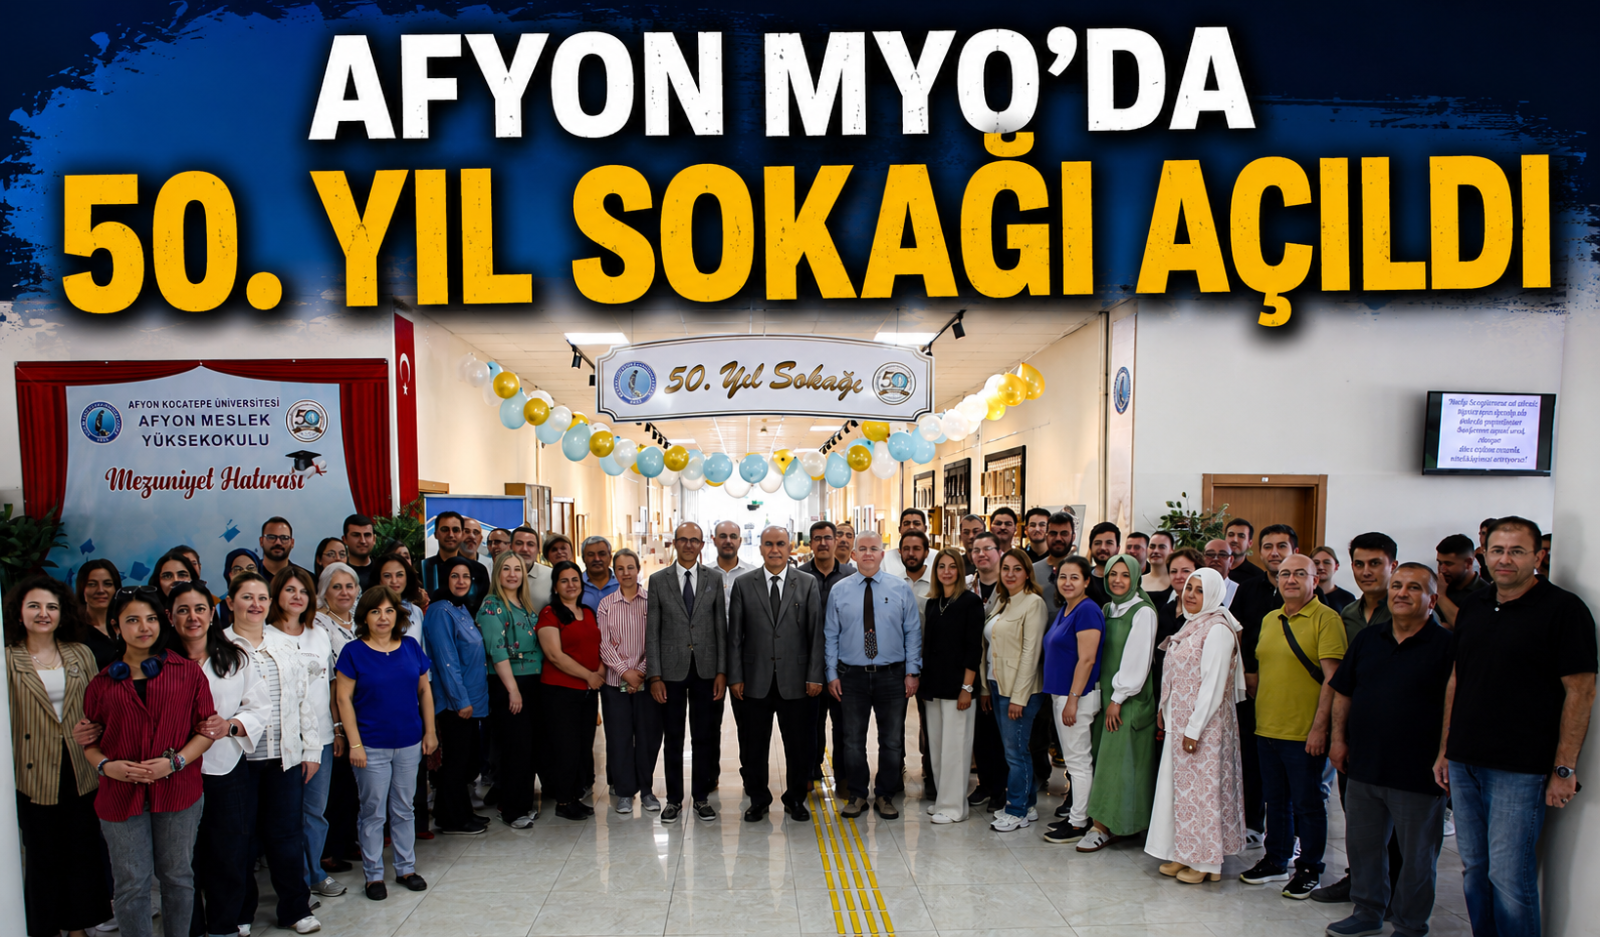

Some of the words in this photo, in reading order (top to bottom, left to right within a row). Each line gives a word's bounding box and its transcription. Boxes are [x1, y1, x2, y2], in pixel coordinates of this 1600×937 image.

[664, 363, 711, 395] 50.
[769, 360, 864, 402] Sokağı
[128, 400, 160, 409] AFYON
[162, 399, 213, 409] KOCATEPE
[215, 397, 280, 408] ÜNİVERSİTESİ
[138, 414, 196, 427] AFYON
[201, 413, 271, 427] MESLEK
[141, 432, 270, 447] YÜKSEKOKULU
[105, 466, 215, 500] Mezuniyet
[220, 465, 306, 491] Hatırası
